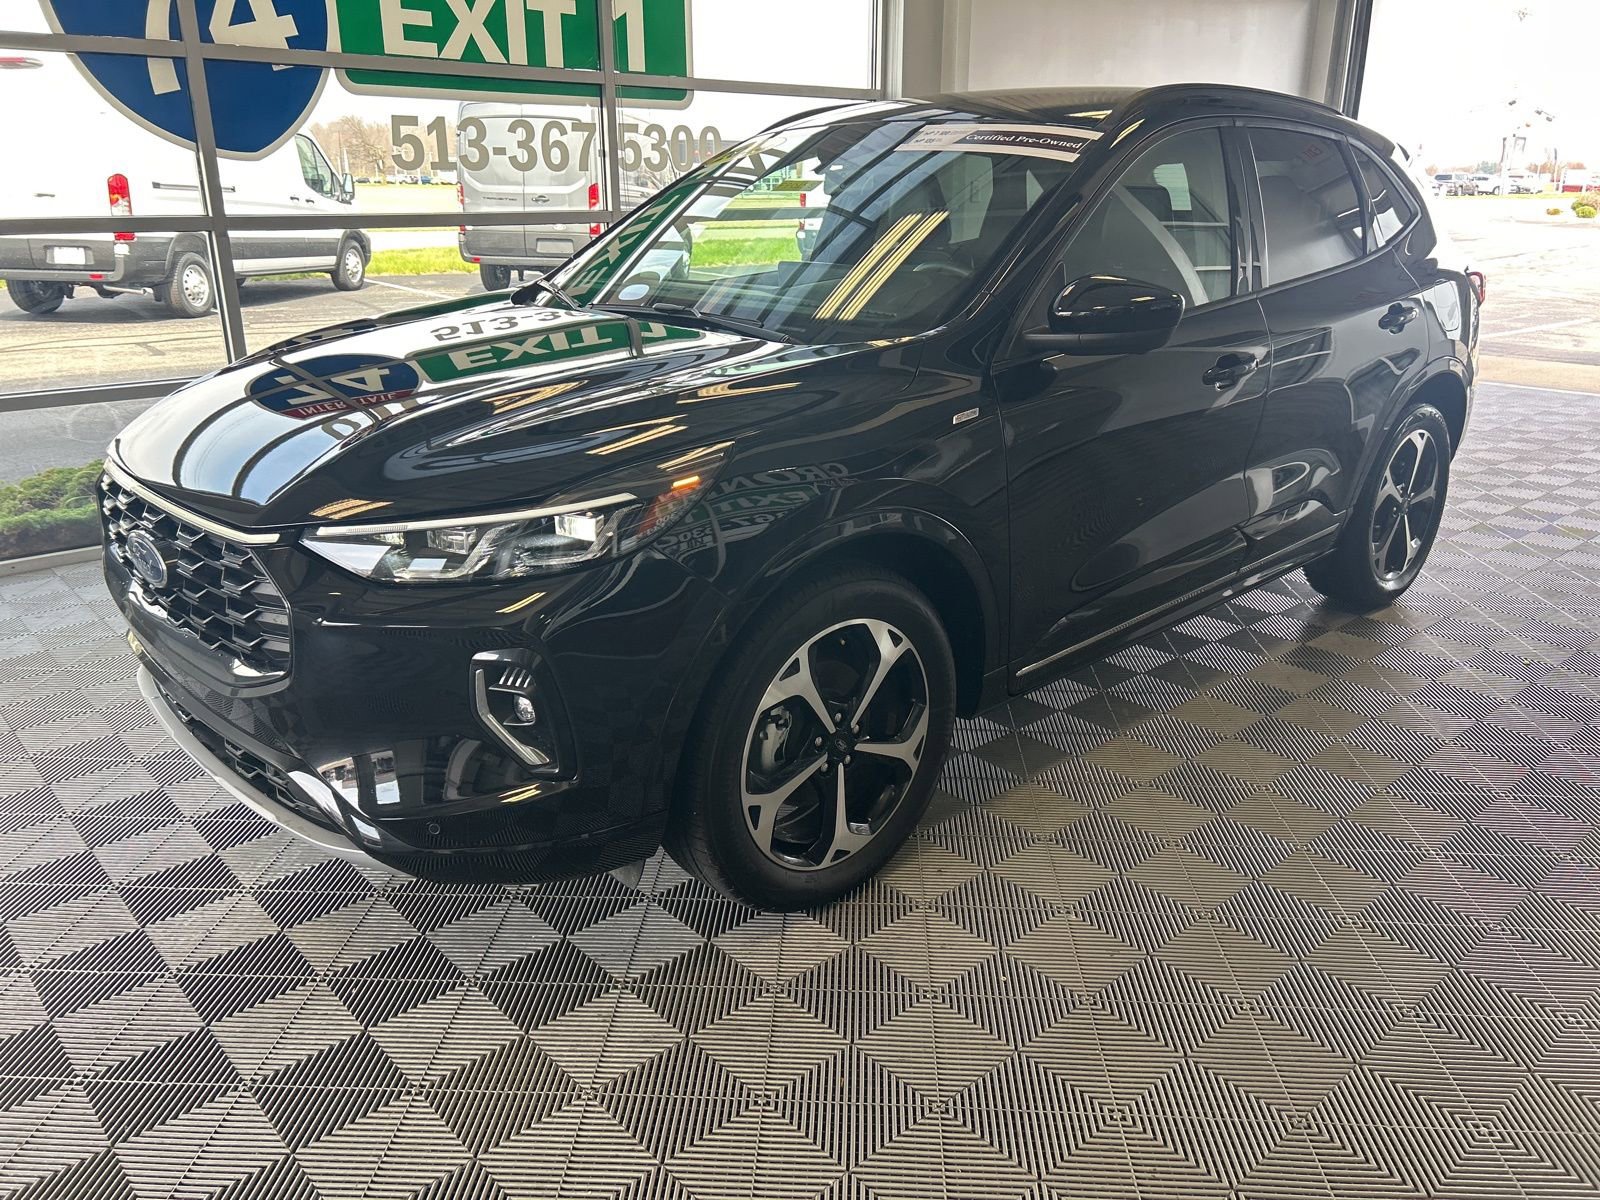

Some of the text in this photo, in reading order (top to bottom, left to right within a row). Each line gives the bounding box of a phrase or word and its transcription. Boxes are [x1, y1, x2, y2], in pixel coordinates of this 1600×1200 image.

[379, 0, 646, 73] EXIT 1
[966, 134, 1015, 142] Certified
[1016, 135, 1082, 149] Pre-Owned
